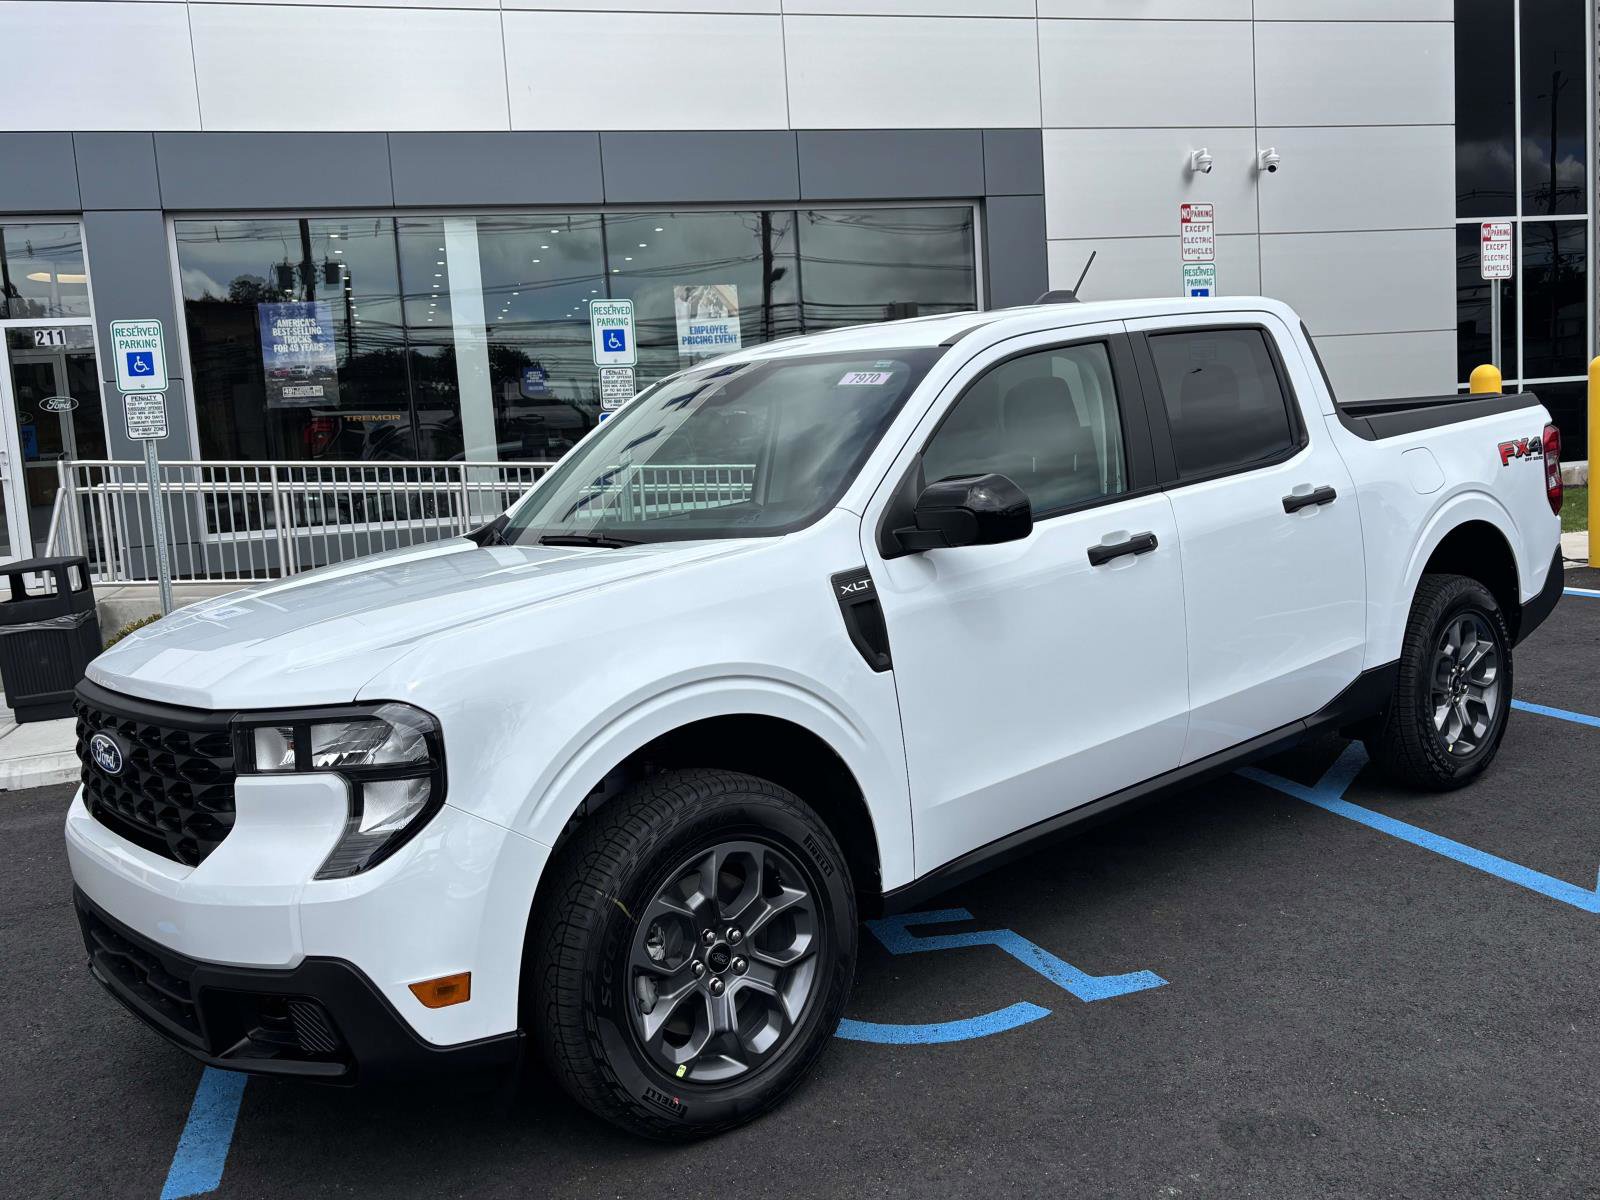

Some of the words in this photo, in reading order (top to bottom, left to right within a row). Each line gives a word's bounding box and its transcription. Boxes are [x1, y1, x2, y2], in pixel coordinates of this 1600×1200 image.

[1182, 208, 1190, 219] NO
[1191, 209, 1212, 218] PARKING
[1185, 225, 1210, 233] EXCEPT
[1184, 247, 1213, 255] VEHICLES
[1184, 268, 1215, 277] RESERVED
[1186, 278, 1213, 287] PARKING
[593, 306, 631, 316] RESERVED
[276, 318, 316, 328] AMERICA'S
[596, 317, 629, 327] PARKING
[115, 326, 159, 337] RESERVED
[272, 326, 322, 336] BEST-SELLING
[689, 325, 728, 335] EMPLOYEE
[36, 330, 65, 345] 211
[283, 335, 312, 343] TRUCKS
[682, 335, 714, 345] PRICING
[714, 334, 738, 344] EVENT
[119, 338, 157, 349] PARKING
[273, 344, 289, 353] FOR
[289, 343, 299, 352] 49
[300, 342, 324, 352] YEARS
[849, 373, 881, 384] 7970
[344, 414, 401, 422] TREMOR
[1498, 436, 1542, 466] FX4
[840, 579, 871, 595] XLT
[803, 833, 833, 877] PIRELLI
